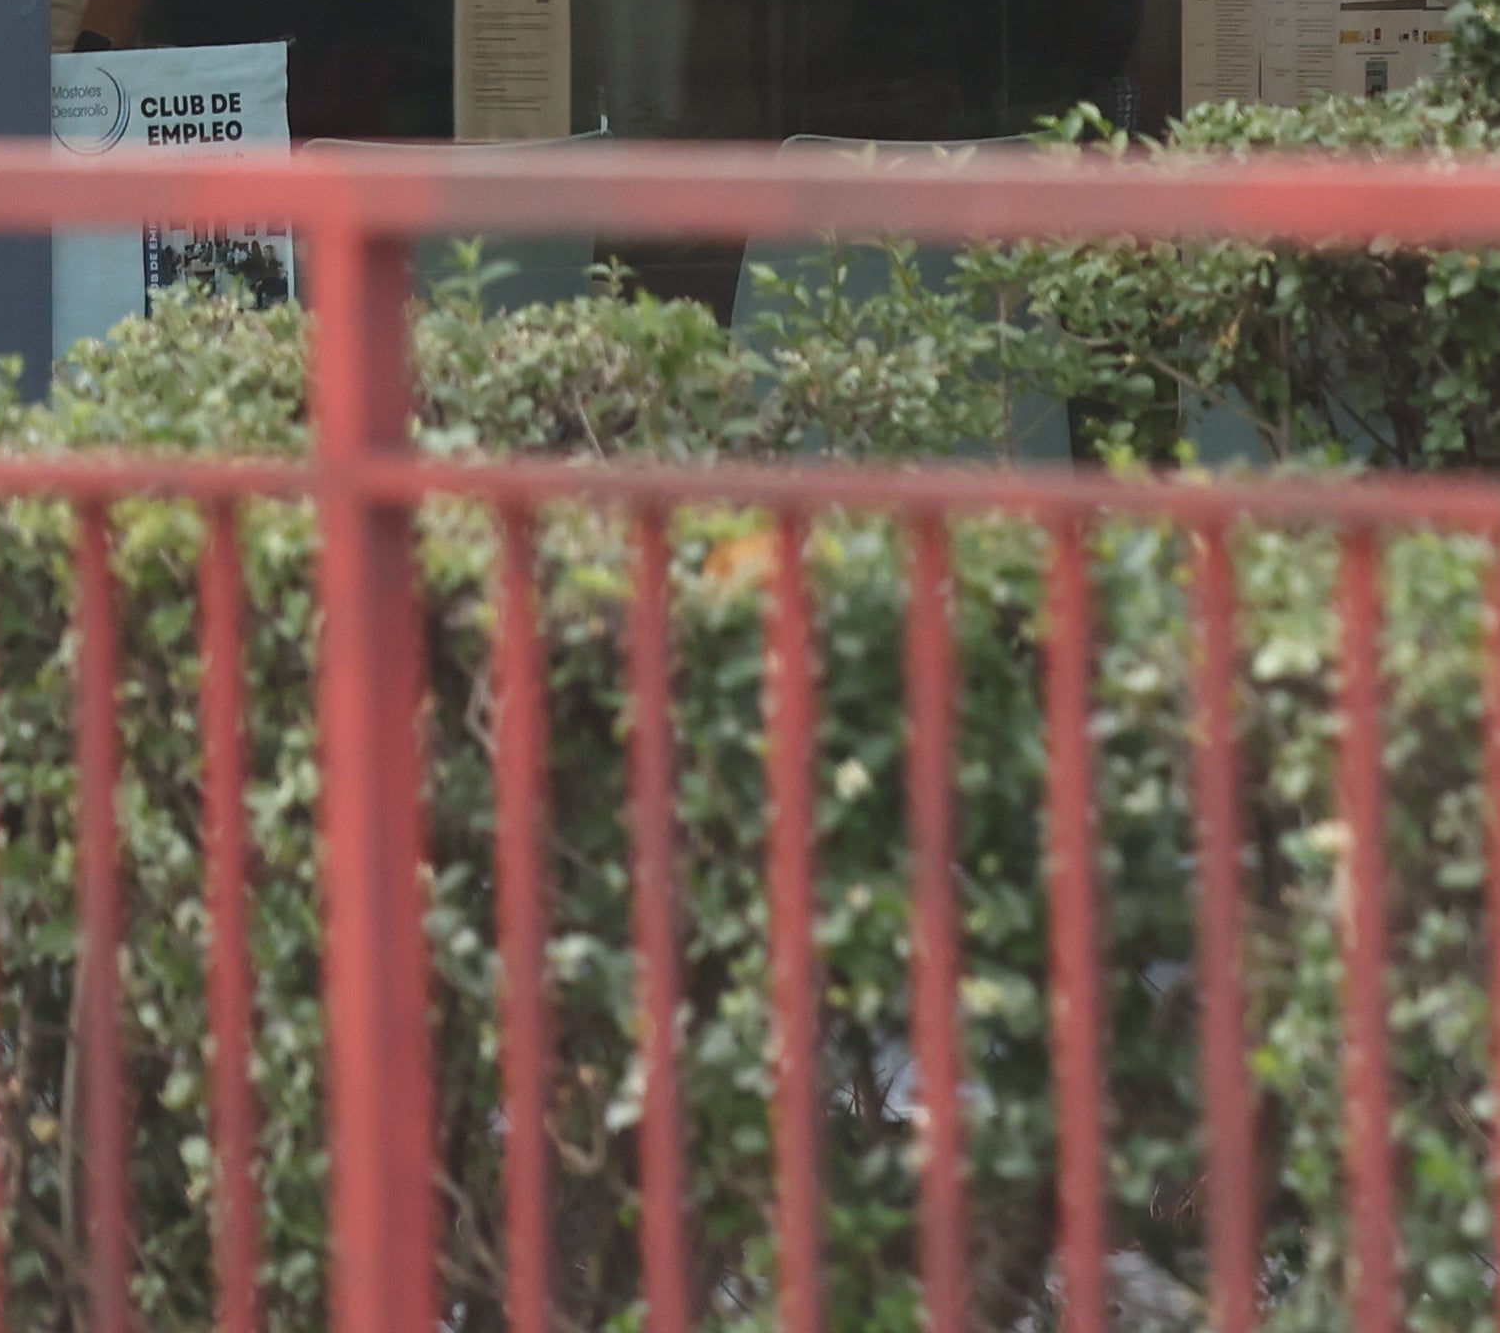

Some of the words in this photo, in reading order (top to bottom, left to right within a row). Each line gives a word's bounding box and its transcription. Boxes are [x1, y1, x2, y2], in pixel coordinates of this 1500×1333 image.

[52, 106, 108, 119] Desarrollo
[141, 94, 205, 118] CLUB
[211, 93, 241, 113] DE
[148, 121, 243, 146] EMPLEO
